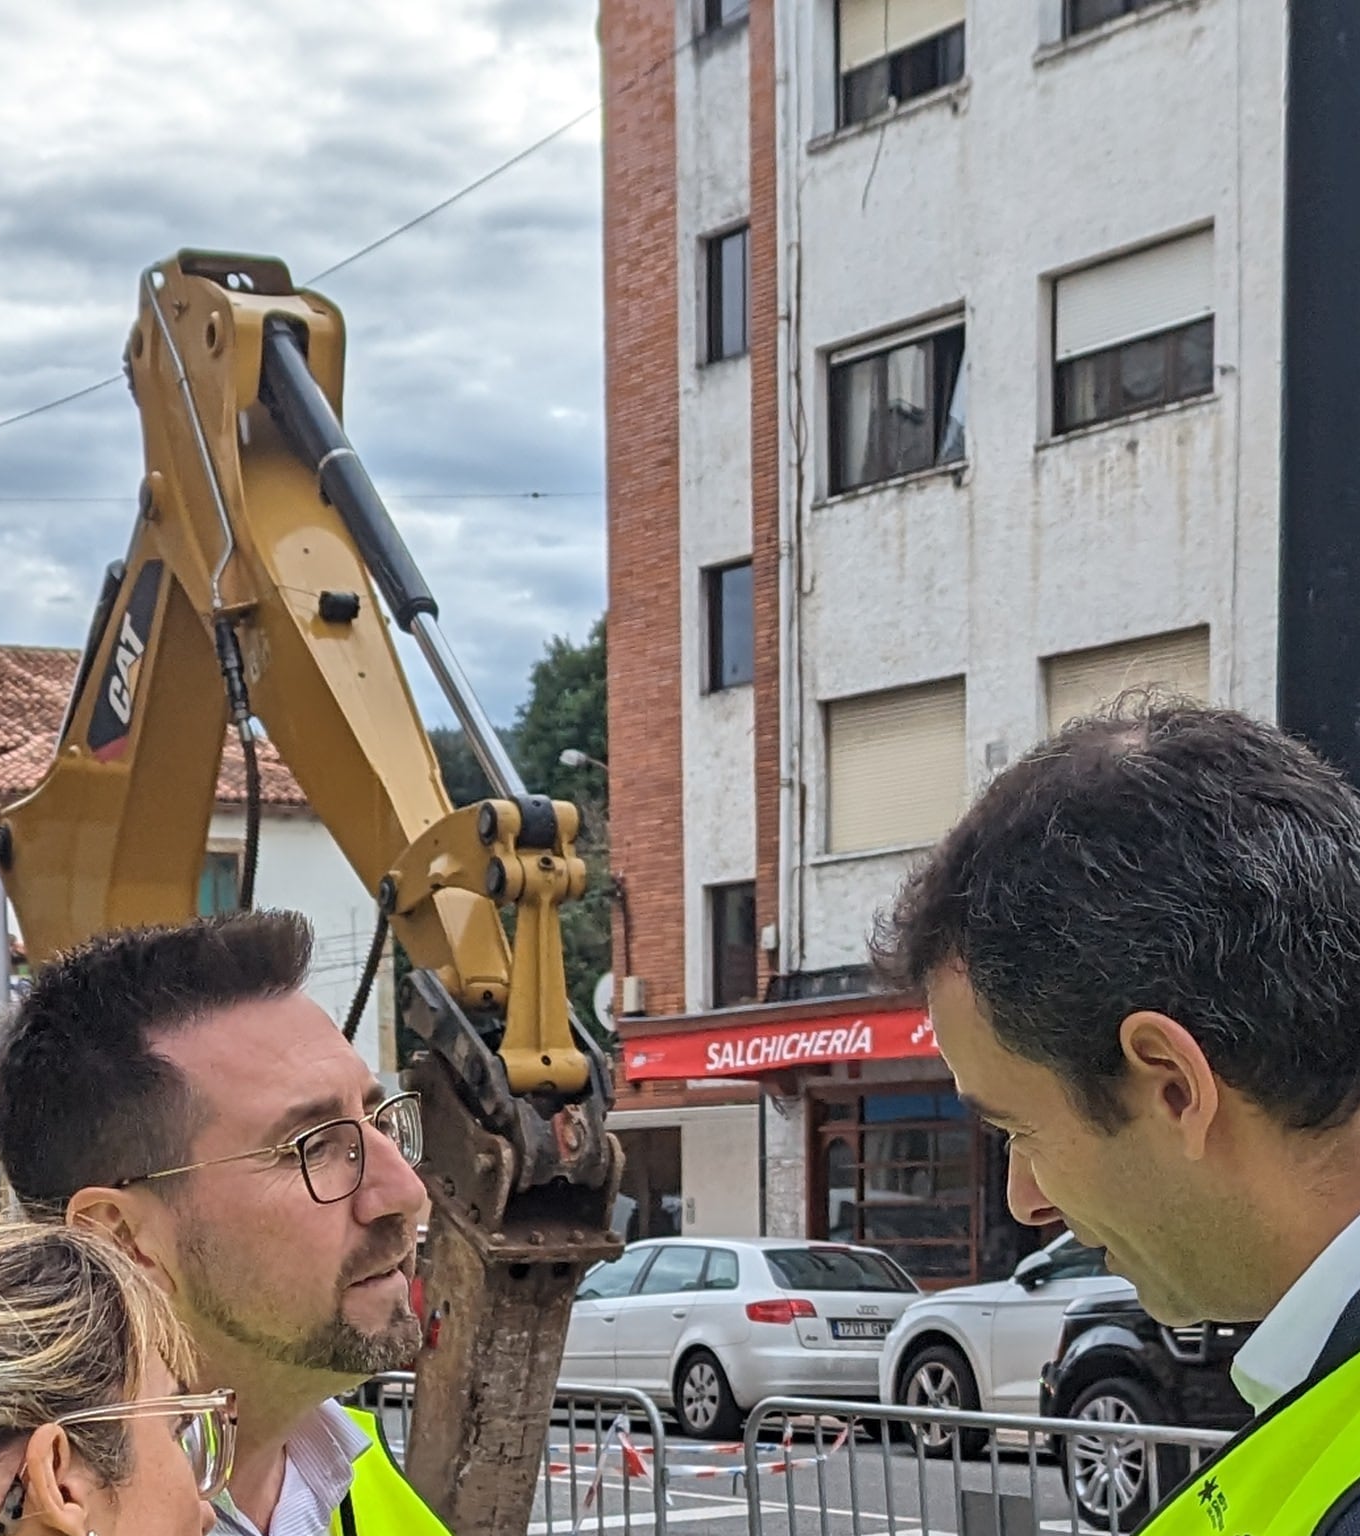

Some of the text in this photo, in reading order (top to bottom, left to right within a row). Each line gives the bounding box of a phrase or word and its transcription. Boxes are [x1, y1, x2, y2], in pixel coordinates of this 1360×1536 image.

[108, 611, 145, 725] CAT
[705, 1020, 872, 1071] SALCHICHERÍA
[841, 1321, 867, 1337] 1701
